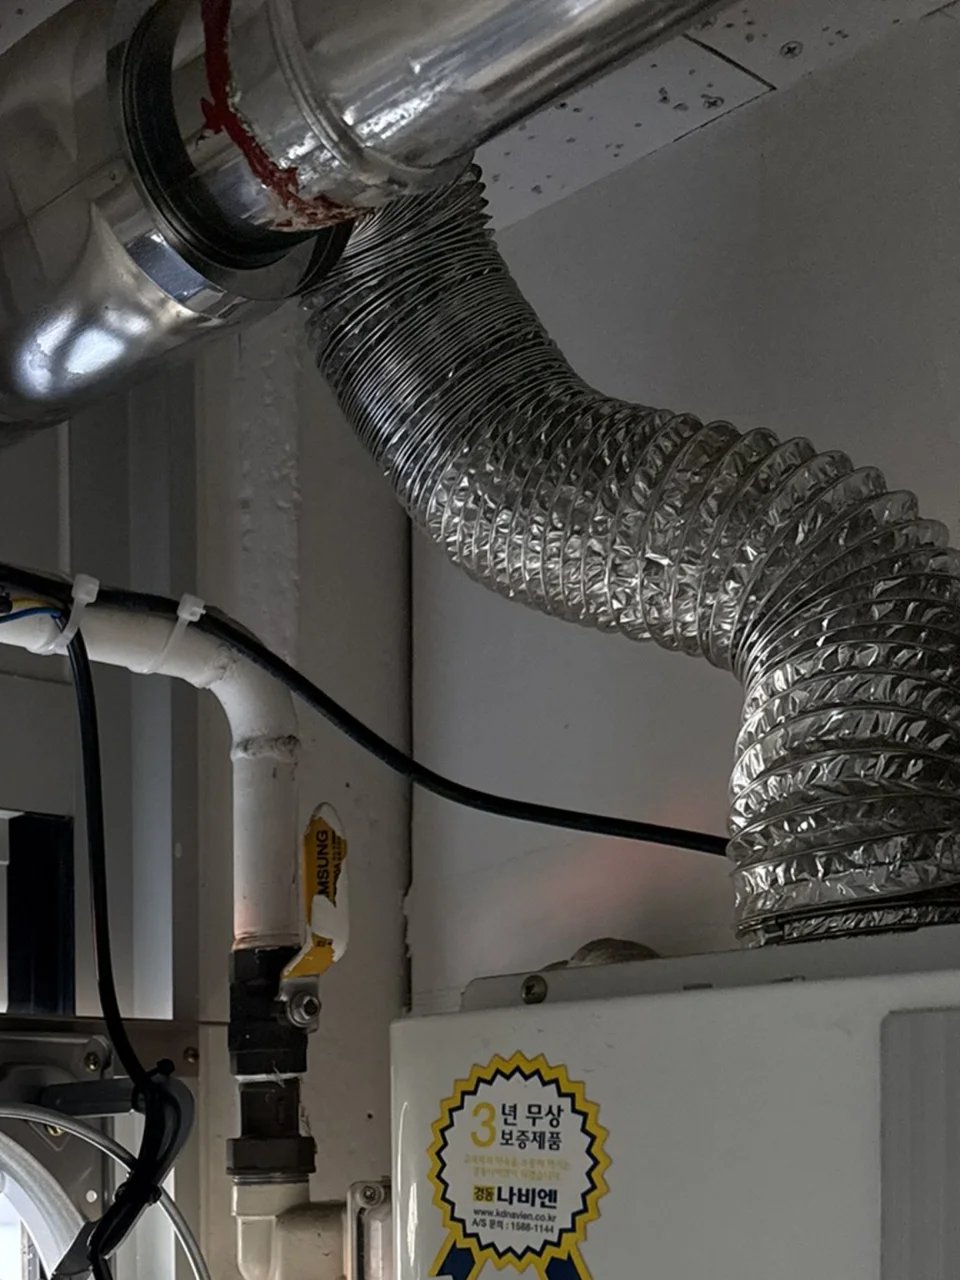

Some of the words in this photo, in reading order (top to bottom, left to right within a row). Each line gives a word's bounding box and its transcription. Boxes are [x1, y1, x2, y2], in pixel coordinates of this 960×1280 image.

[316, 830, 329, 898] MSUNG
[471, 1101, 497, 1148] 3
[501, 1103, 517, 1126] 년
[526, 1104, 564, 1128] 무상
[500, 1130, 562, 1151] 보증제품
[474, 1186, 495, 1202] 경동
[497, 1186, 558, 1209] 나비엔
[472, 1218, 487, 1228] A/S
[511, 1221, 555, 1233] 1588-1144
[473, 1208, 557, 1222] www.kdnavien.co.kr
